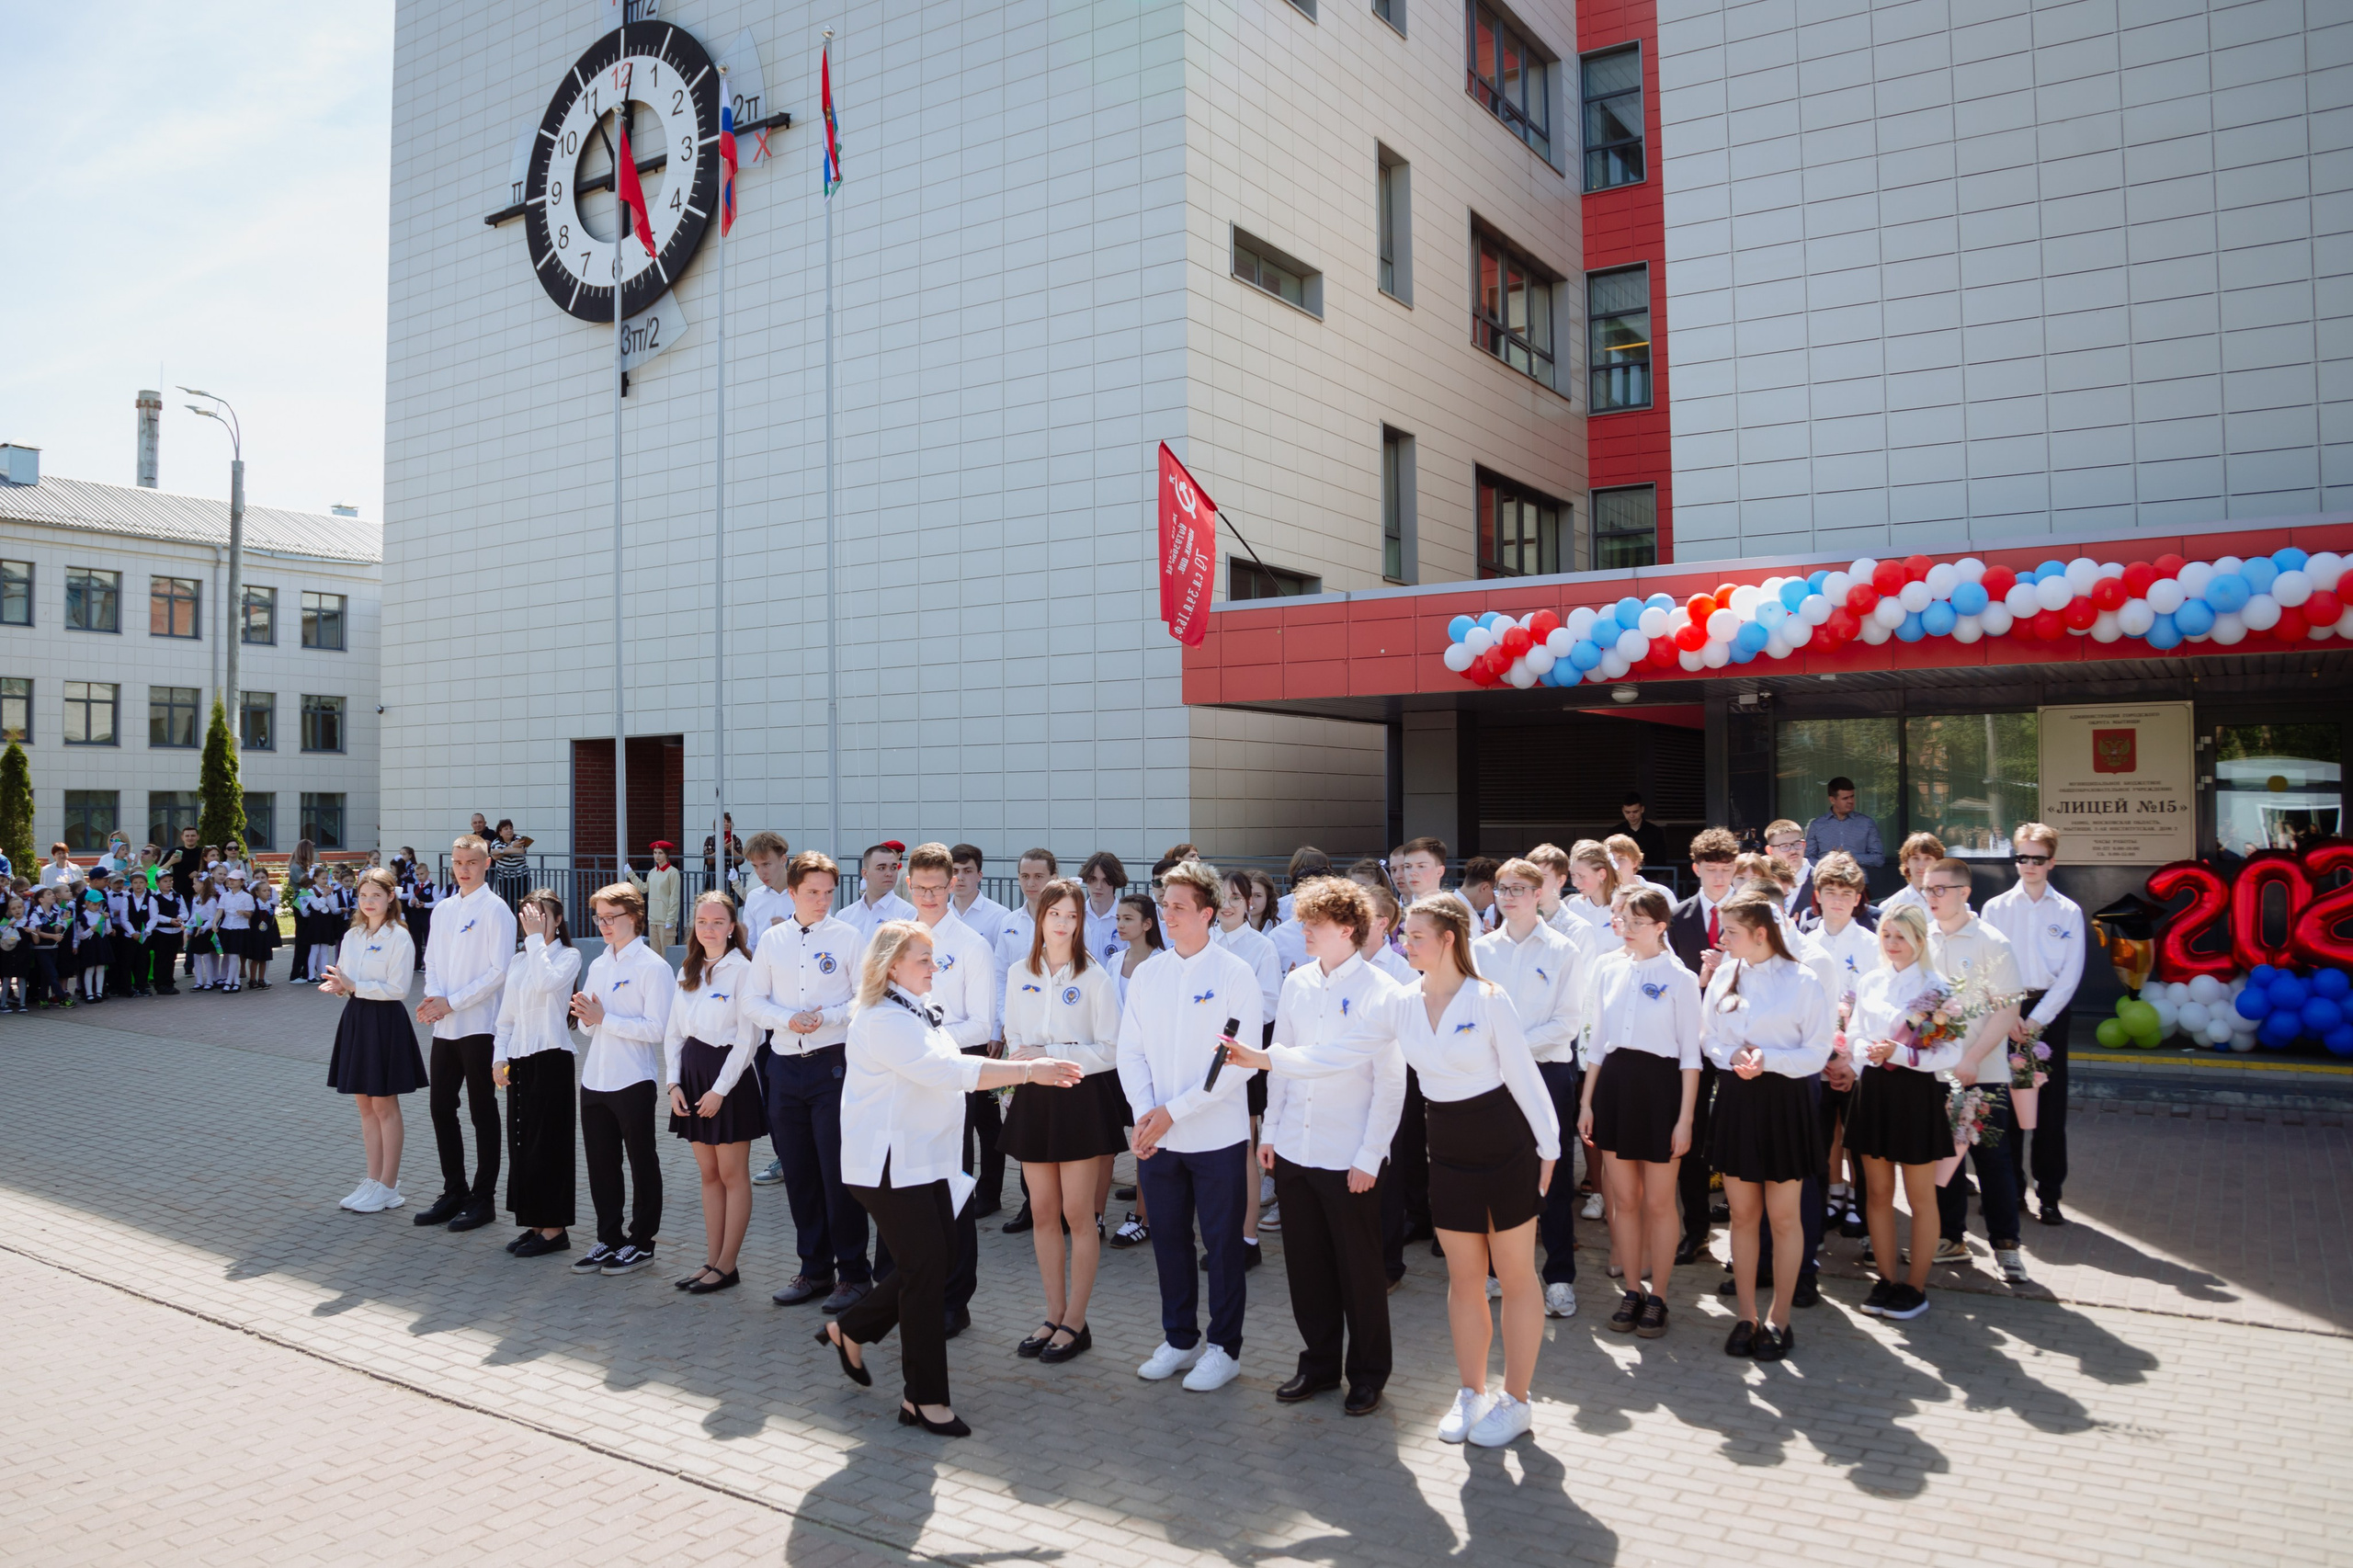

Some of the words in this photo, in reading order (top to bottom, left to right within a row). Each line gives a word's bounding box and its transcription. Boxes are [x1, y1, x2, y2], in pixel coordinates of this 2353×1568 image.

[610, 62, 632, 91] 12
[650, 63, 658, 88] 1
[581, 87, 599, 115] 11
[672, 89, 685, 116] 2
[733, 94, 759, 126] 2π
[558, 131, 577, 159] 10
[681, 136, 693, 162] 3
[551, 181, 563, 205] 9
[670, 187, 682, 213] 4
[558, 225, 569, 249] 8
[580, 251, 591, 277] 7
[2048, 798, 2129, 815] «ЛИЦЕЙ
[2136, 800, 2188, 813] №15»
